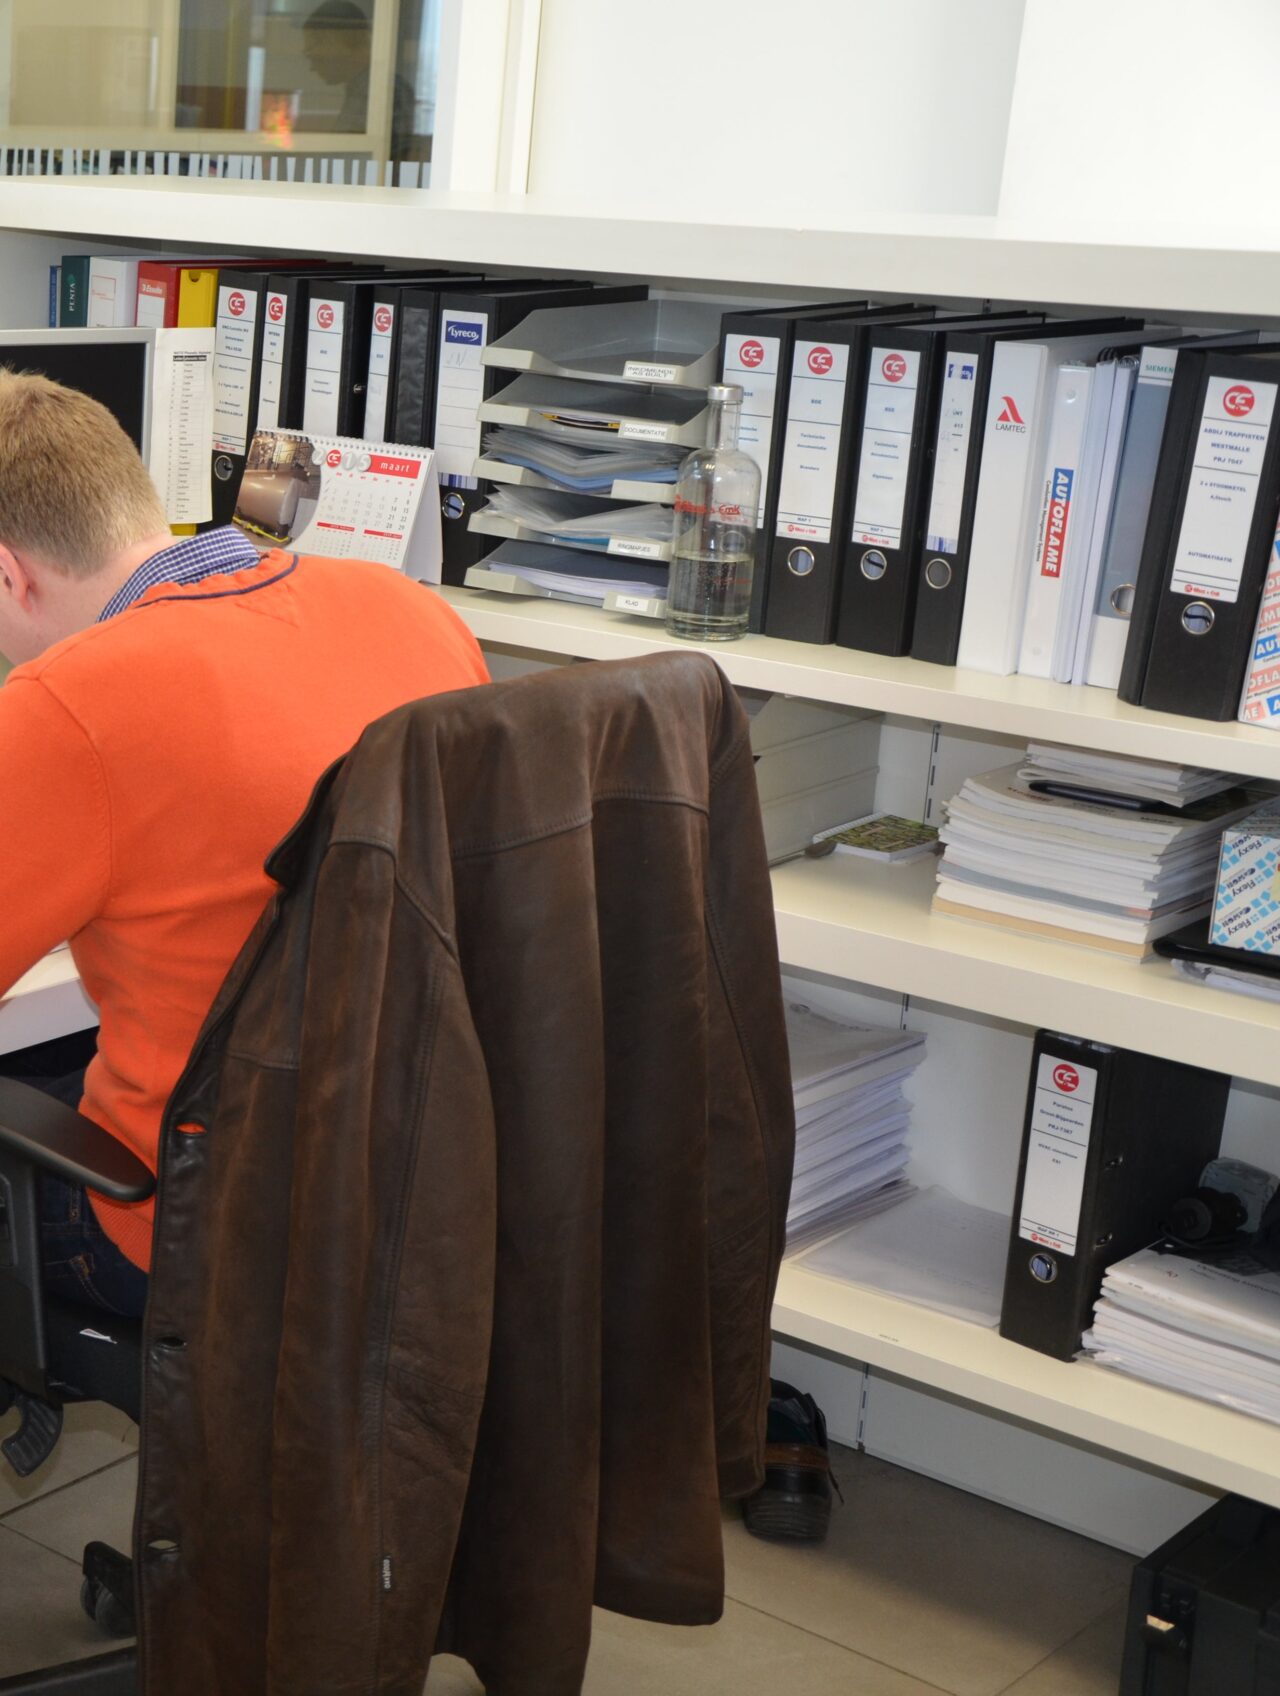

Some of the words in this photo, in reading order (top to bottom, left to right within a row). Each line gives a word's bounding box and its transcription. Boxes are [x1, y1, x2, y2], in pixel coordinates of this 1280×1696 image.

[68, 282, 76, 312] PENTA
[450, 327, 477, 338] Lyreco
[995, 423, 1027, 434] LAMTEC
[1224, 430, 1265, 441] TRAPPISTEN
[1211, 442, 1250, 453] WESTMALLE
[380, 461, 411, 473] maart
[1045, 471, 1069, 573] AUTOFLAME
[1237, 839, 1263, 857] Flexy
[1231, 878, 1257, 897] Flexy
[1227, 918, 1253, 936] Flexy
